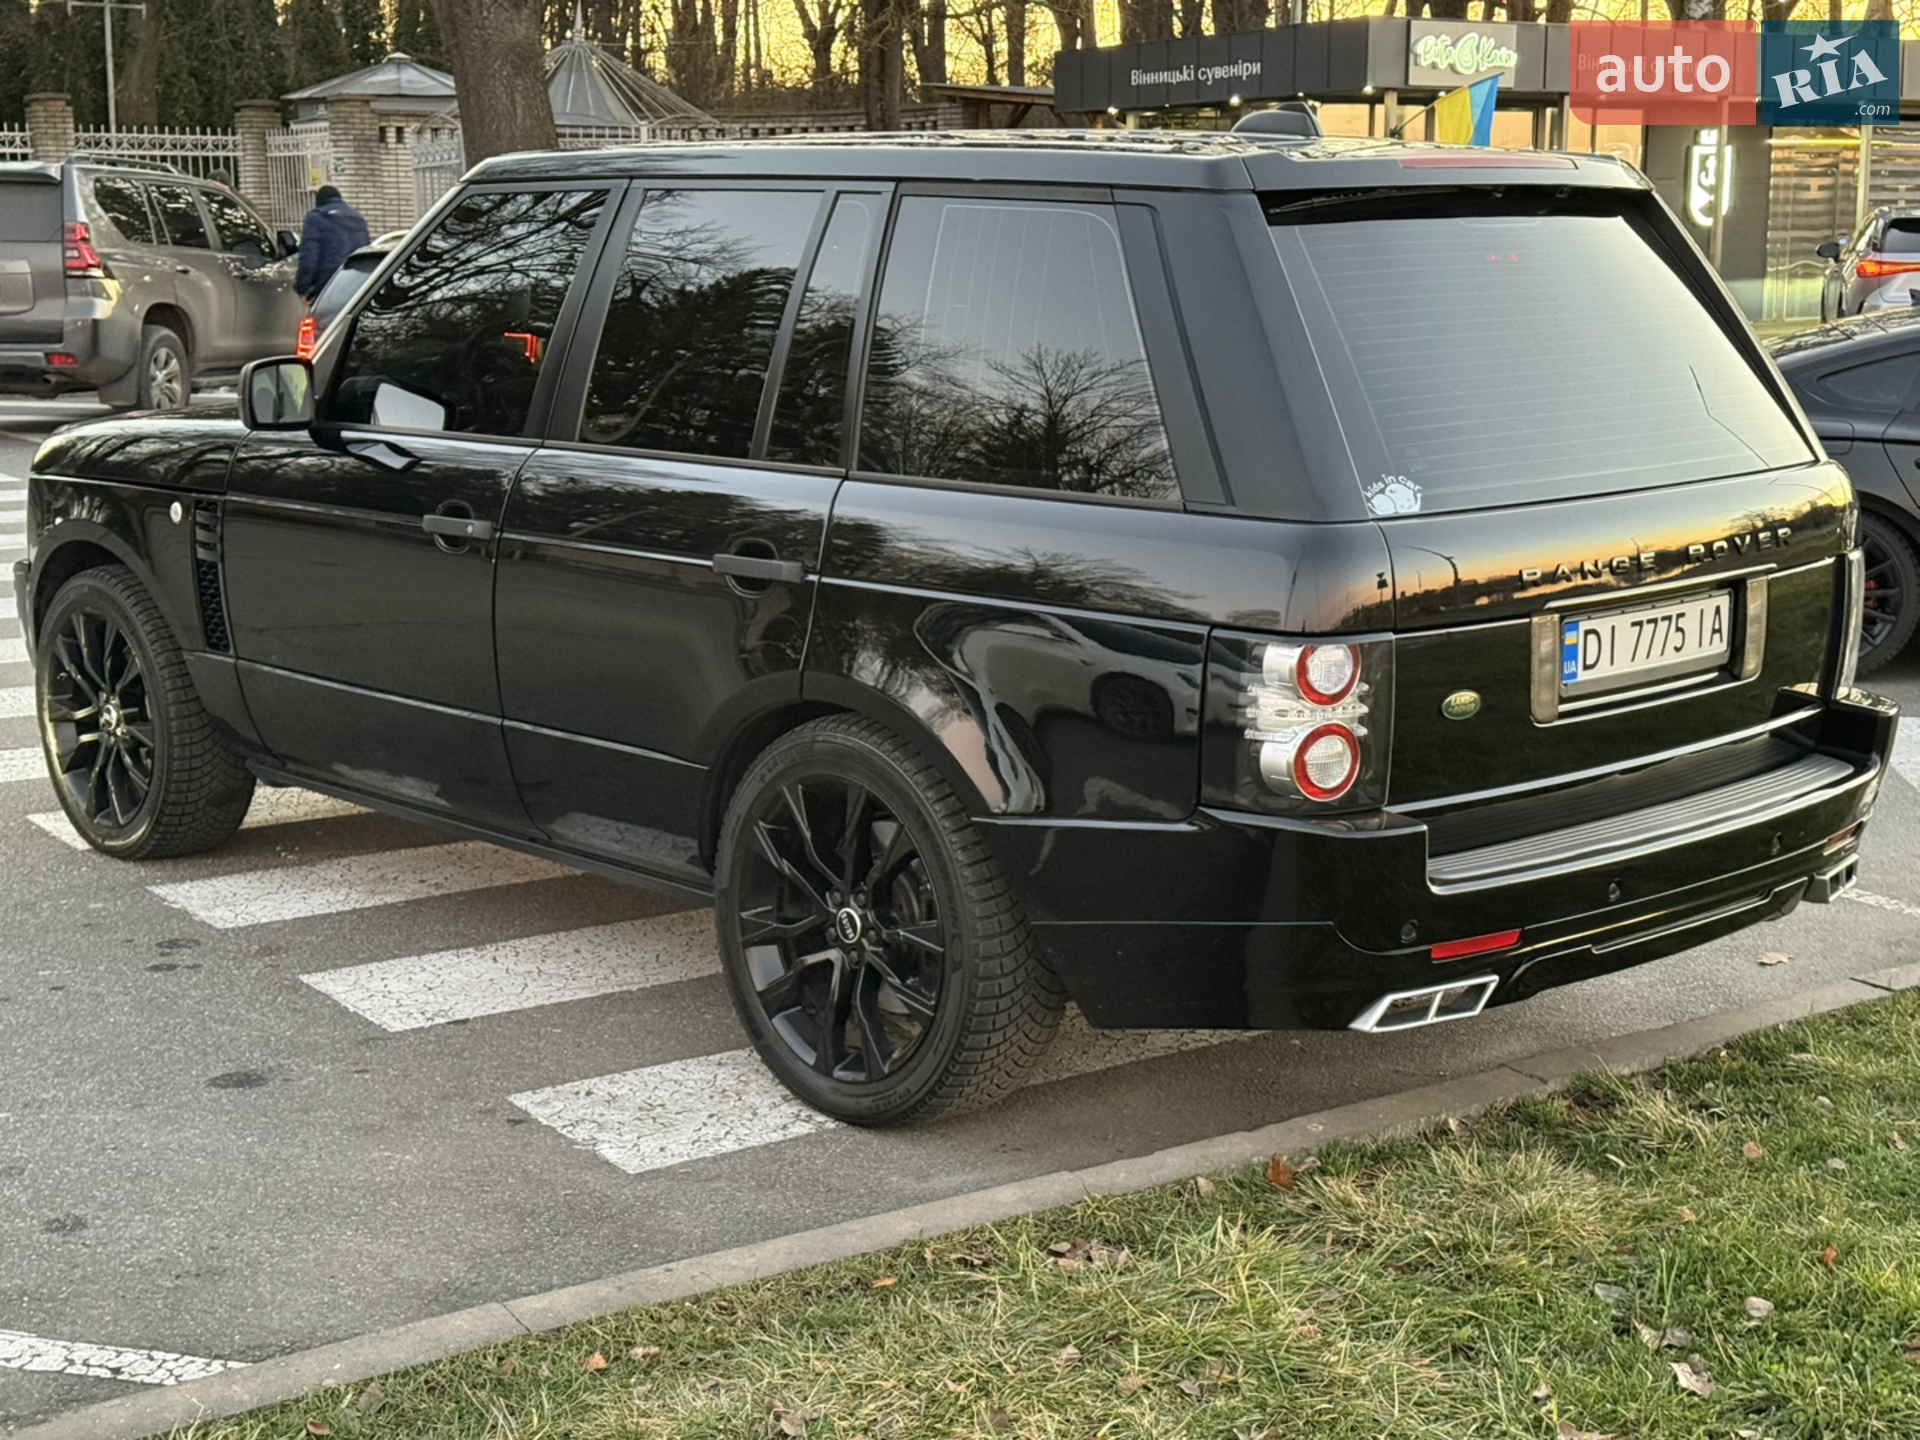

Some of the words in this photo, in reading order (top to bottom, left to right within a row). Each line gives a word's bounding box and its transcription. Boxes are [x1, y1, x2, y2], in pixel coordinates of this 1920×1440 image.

[1131, 64, 1195, 86] Вінницькі
[1197, 59, 1261, 85] сувеніри
[1363, 481, 1385, 498] kids
[1381, 474, 1397, 484] in
[1398, 475, 1422, 491] car
[1519, 551, 1658, 589] RANGE
[1687, 527, 1793, 565] ROVER
[1582, 627, 1615, 671] DI
[1630, 612, 1686, 662] 7775
[1698, 604, 1723, 648] IA
[1564, 660, 1577, 674] UA
